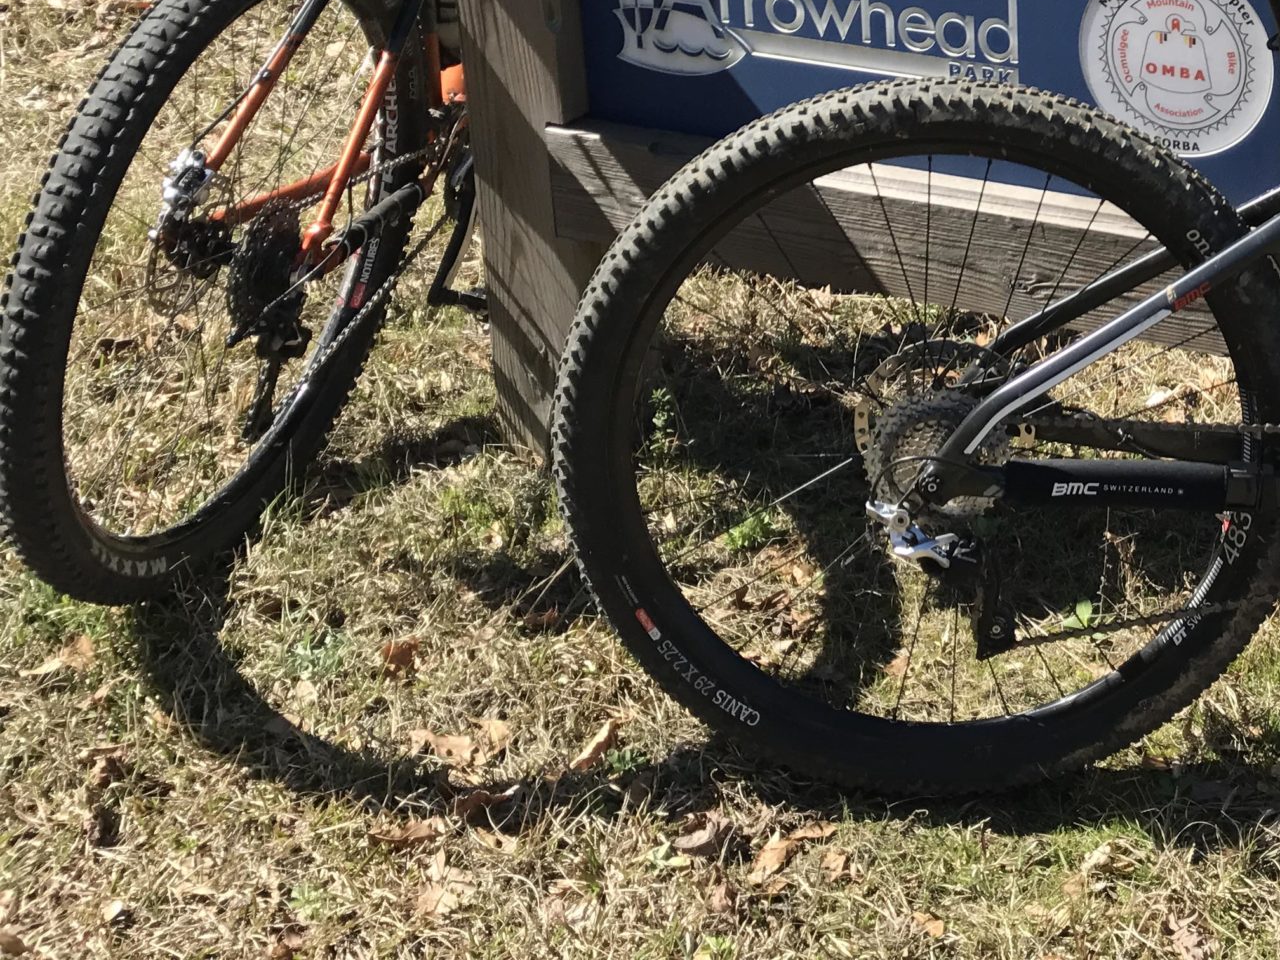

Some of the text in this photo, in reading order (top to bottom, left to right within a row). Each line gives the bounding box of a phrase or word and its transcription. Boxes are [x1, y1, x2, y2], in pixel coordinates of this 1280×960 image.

[1117, 28, 1133, 84] Ocmulgee
[1226, 51, 1237, 75] Bike
[948, 61, 1014, 84] PARK
[1145, 62, 1206, 82] OMBA
[1153, 102, 1204, 118] Association
[384, 93, 399, 154] ARCH
[359, 237, 381, 284] NOTUBES
[1174, 281, 1213, 311] BMC
[1051, 481, 1174, 497] BMC SWITZERLAND
[1172, 625, 1188, 647] DT
[656, 637, 761, 727] CANIS 29 X 2.25
